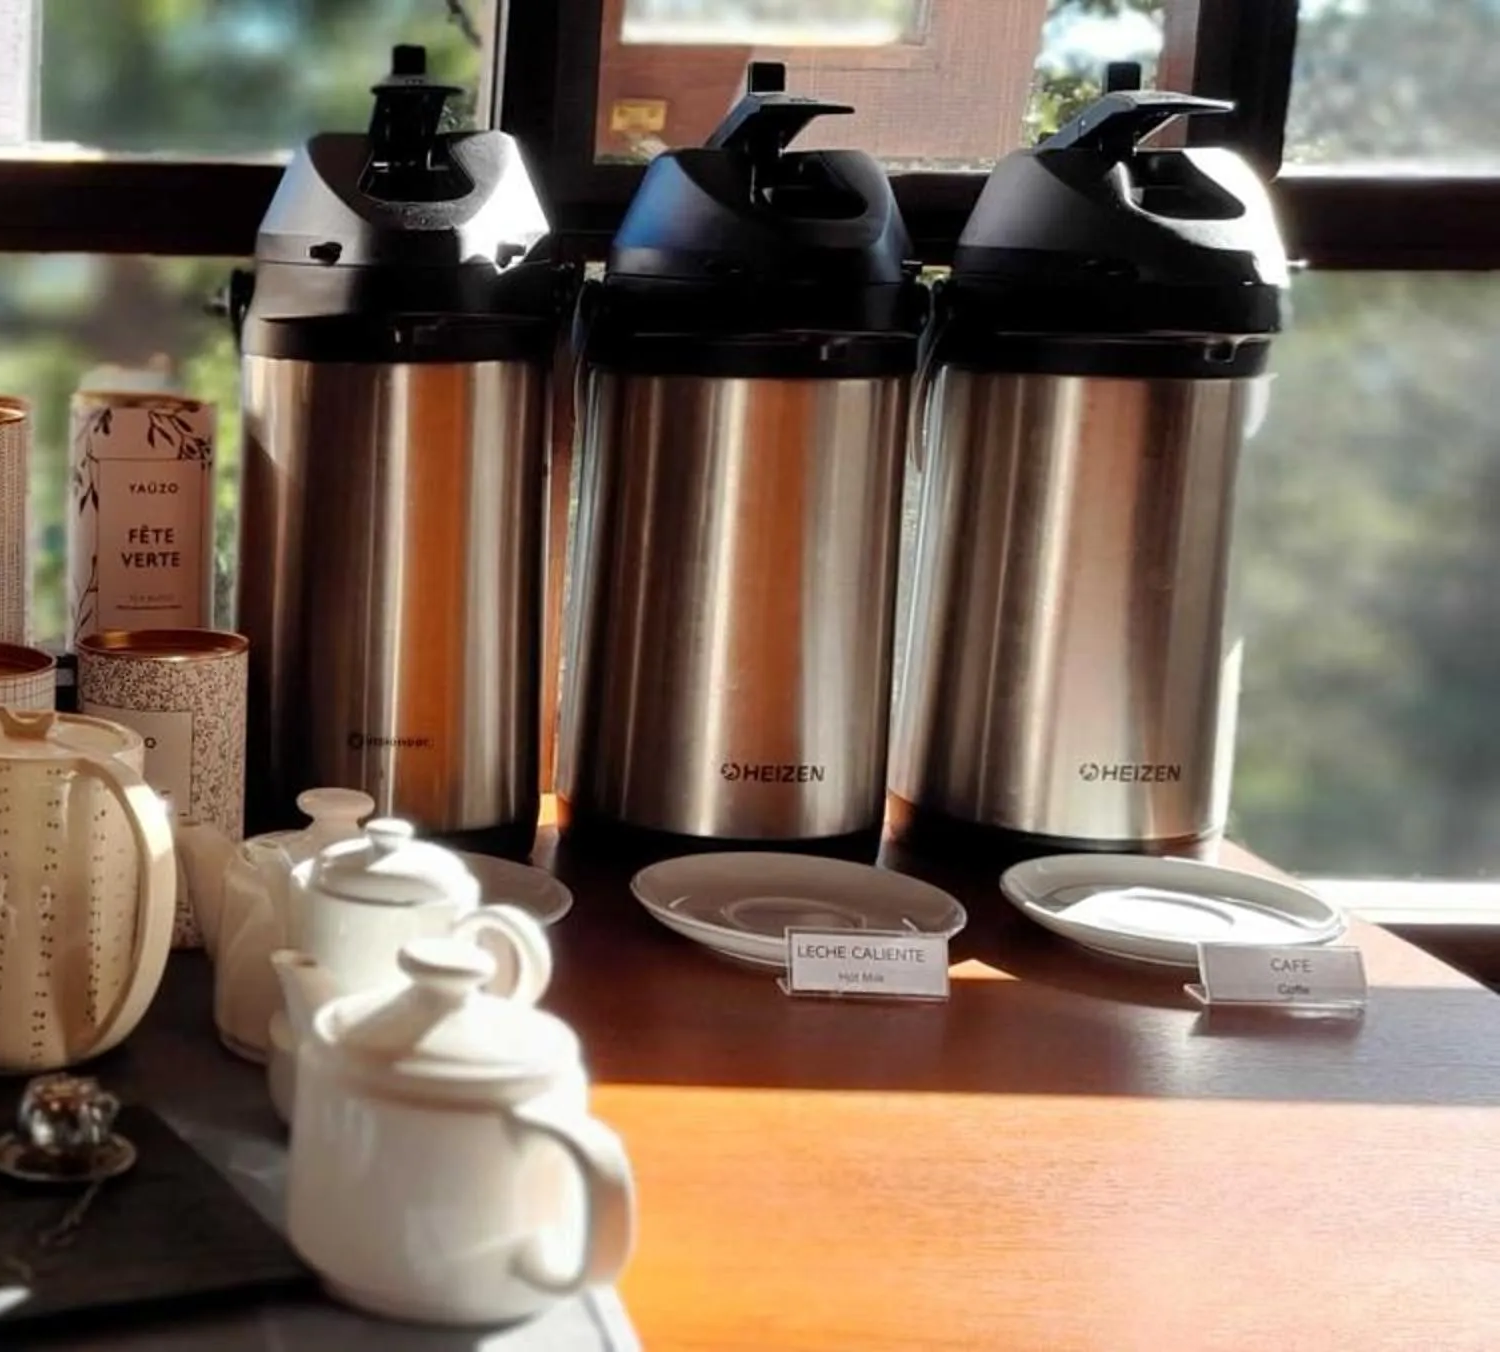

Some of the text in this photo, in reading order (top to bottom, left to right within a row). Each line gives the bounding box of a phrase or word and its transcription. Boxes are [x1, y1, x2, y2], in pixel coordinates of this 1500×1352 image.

[128, 524, 175, 544] FÊTE
[121, 552, 181, 568] VERTE
[743, 763, 826, 783] HEIZEN
[1101, 763, 1182, 783] HEIZEN
[797, 945, 927, 963] LECHE CALIENTE
